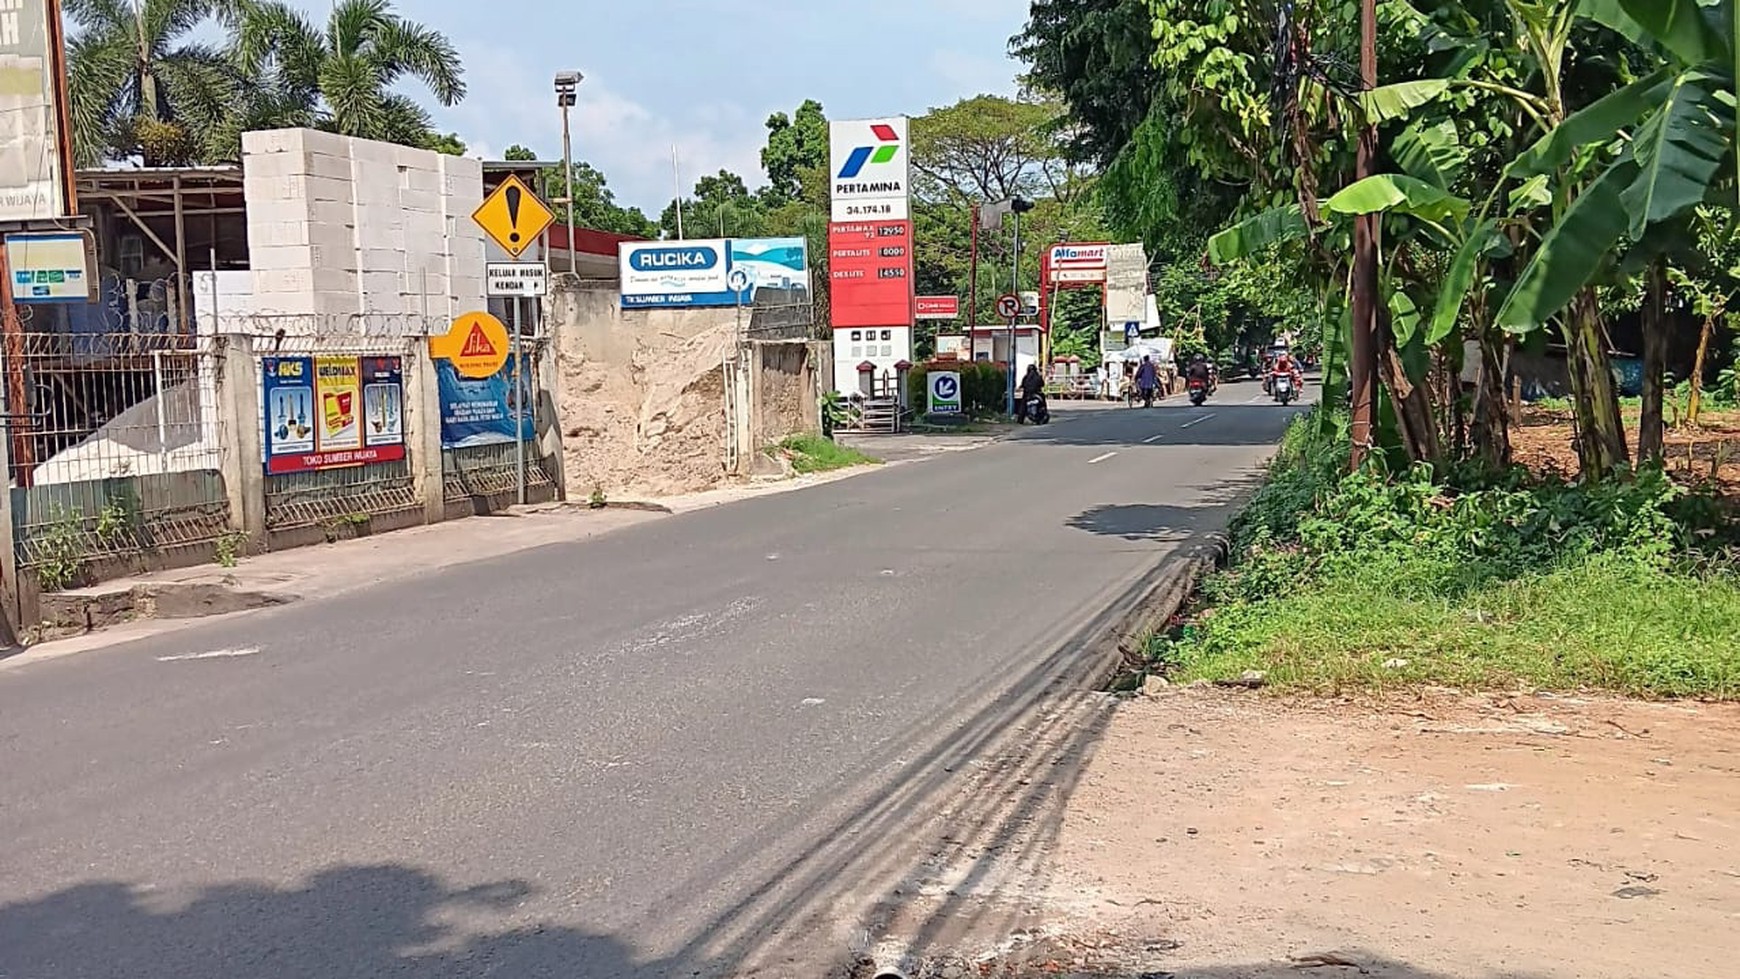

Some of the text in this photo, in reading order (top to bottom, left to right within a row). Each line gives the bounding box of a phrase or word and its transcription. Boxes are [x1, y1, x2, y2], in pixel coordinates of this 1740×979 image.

[836, 181, 901, 194] PERTAMINA
[846, 204, 891, 215] 34.174.18
[640, 252, 706, 266] RUCIKA
[1054, 248, 1105, 258] Alfamart
[489, 268, 516, 277] KELUAR
[464, 332, 491, 354] Sika
[278, 361, 304, 377] AKS
[302, 455, 323, 465] TOKO
[324, 451, 353, 464] SUMBER
